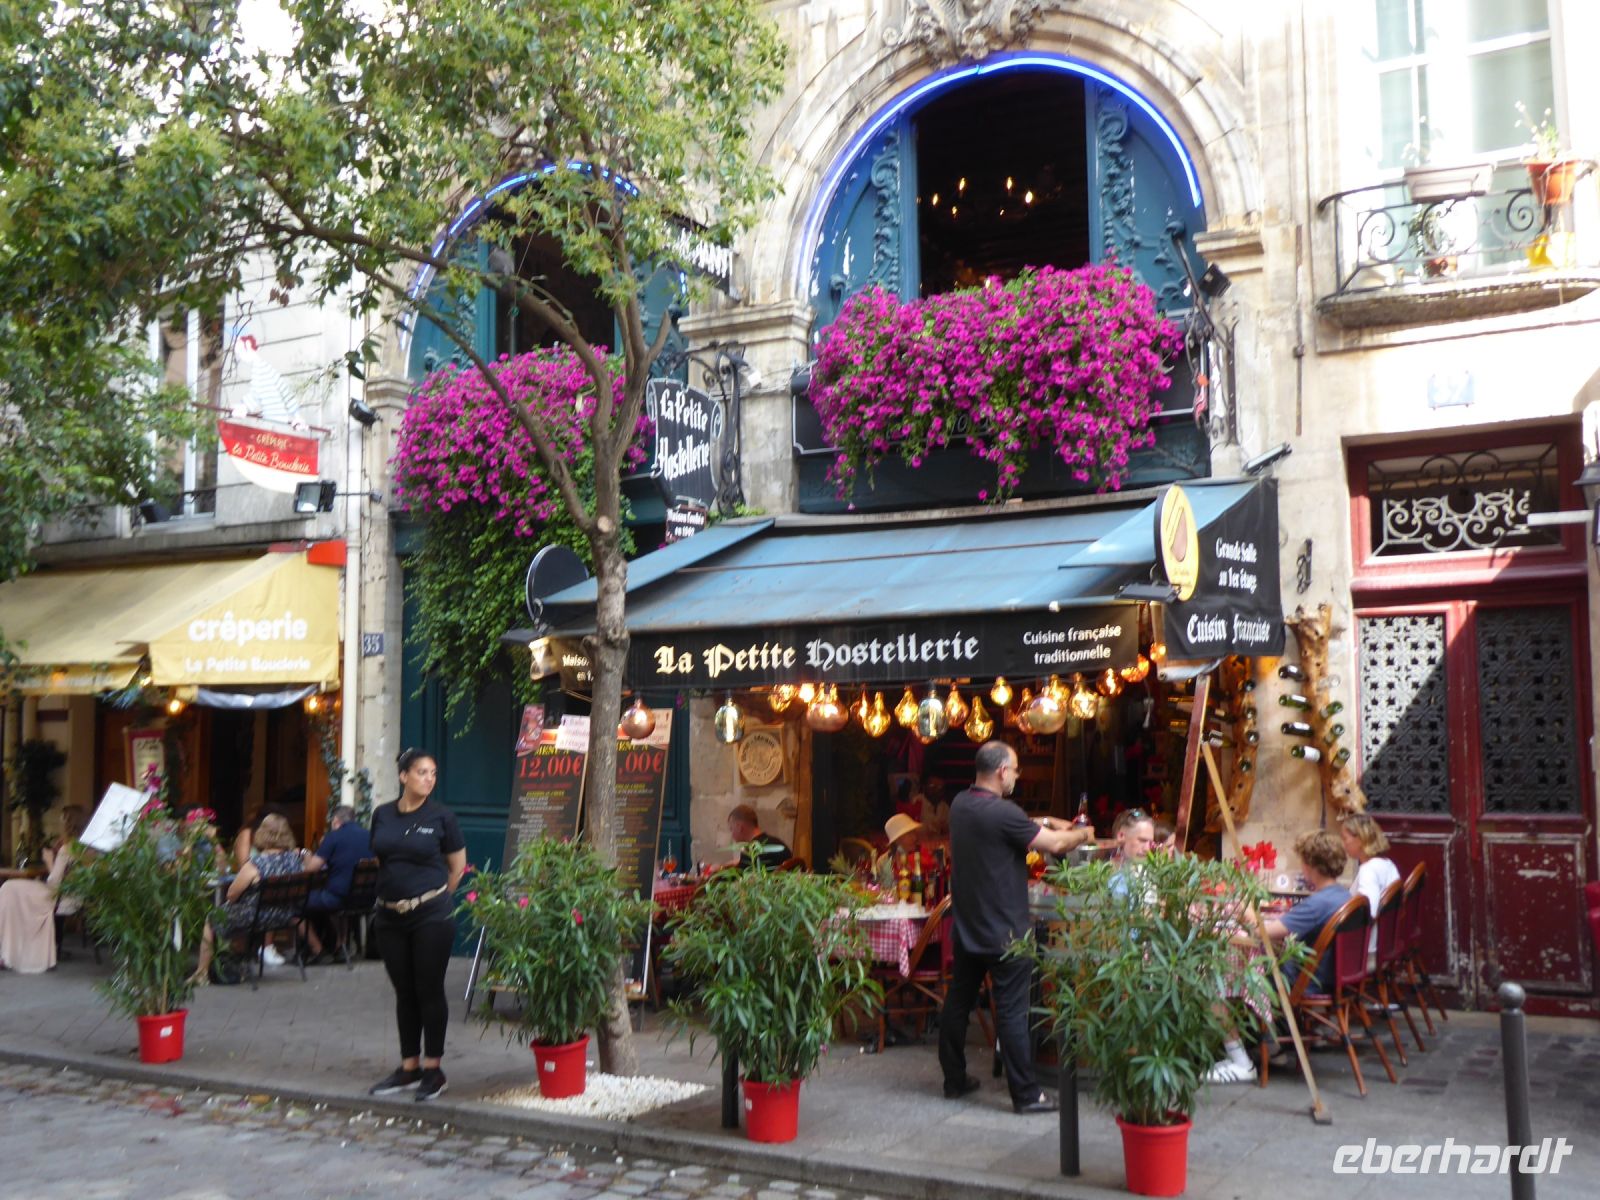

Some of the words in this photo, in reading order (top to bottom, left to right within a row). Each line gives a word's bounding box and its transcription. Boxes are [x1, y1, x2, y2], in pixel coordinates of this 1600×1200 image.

[660, 388, 675, 421] La
[674, 391, 708, 432] Petite
[658, 436, 709, 481] Hostellerie
[189, 611, 307, 645] crêperie
[364, 635, 380, 654] 35
[1023, 630, 1066, 645] Cuisine
[1067, 624, 1122, 642] française
[1186, 612, 1228, 645] Cuisin
[185, 658, 201, 672] La
[206, 658, 247, 672] Petite
[653, 645, 694, 675] La
[702, 641, 797, 679] Petite
[804, 630, 980, 672] Hostellerie
[1034, 644, 1112, 664] traditionnelle
